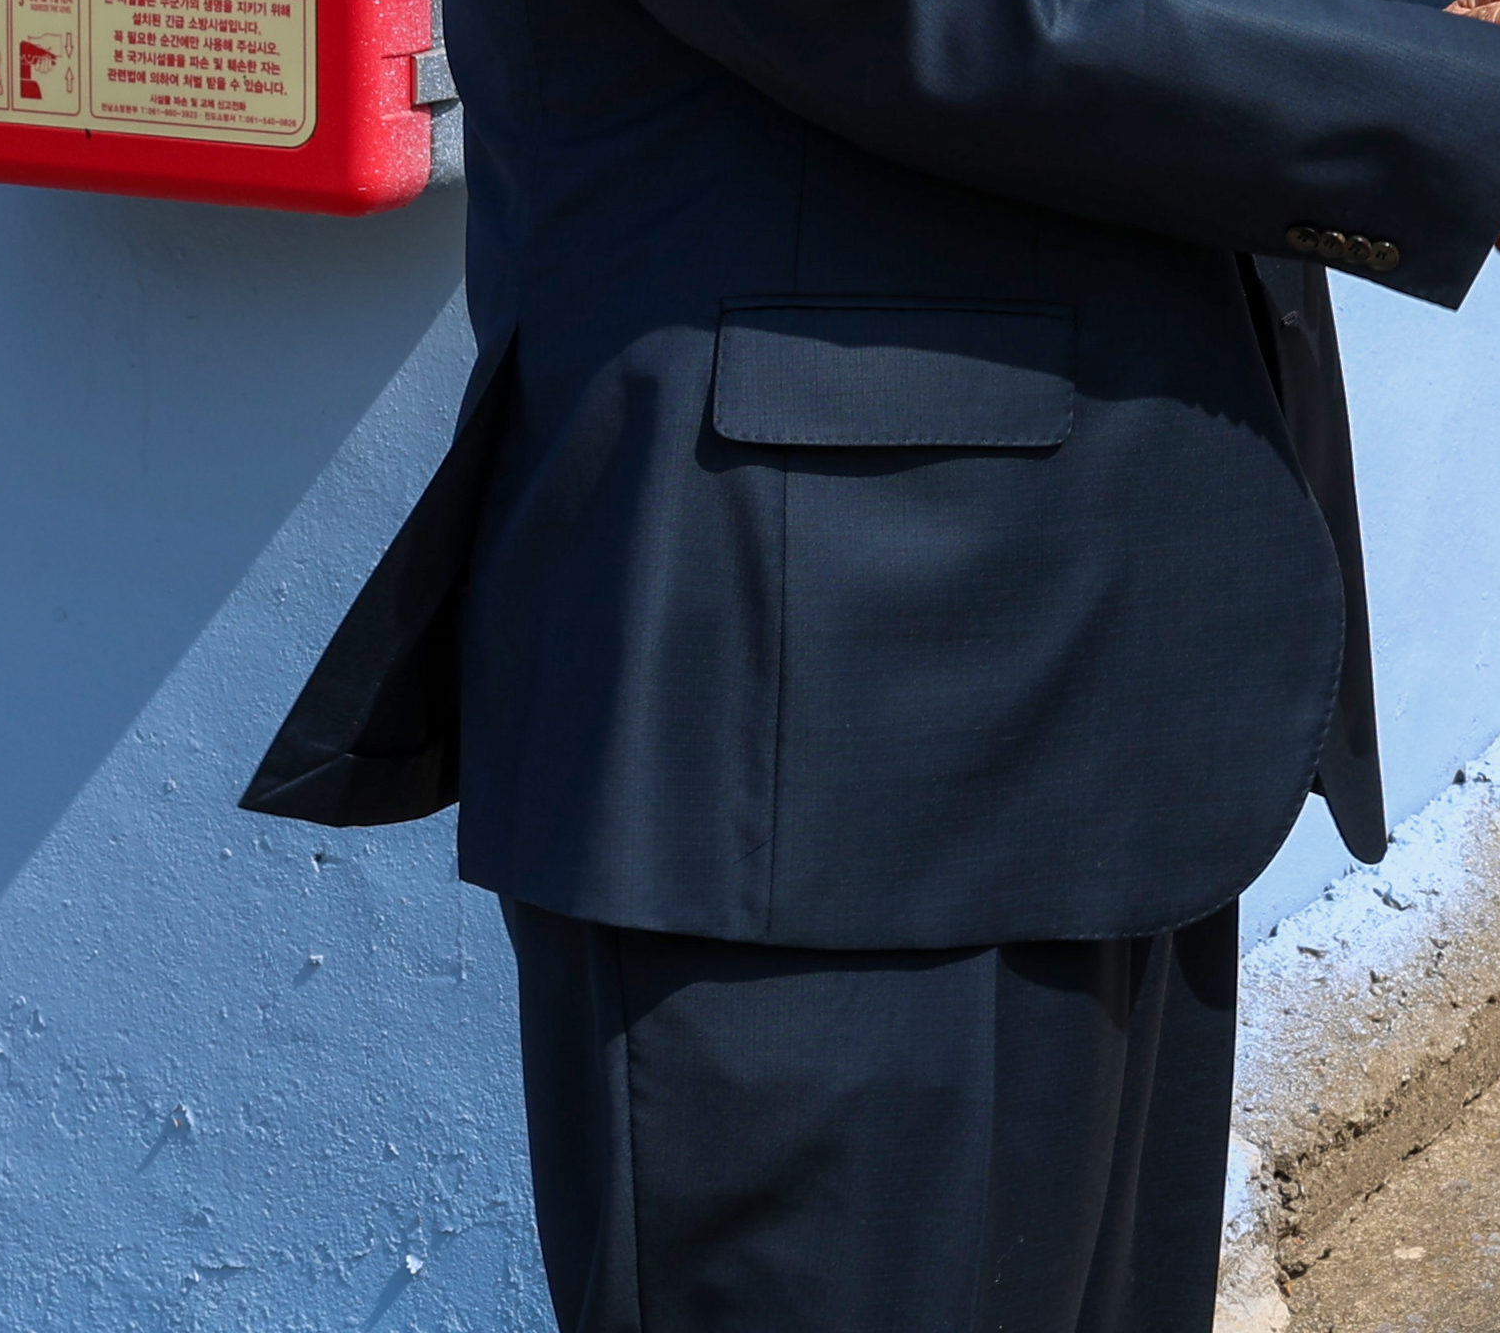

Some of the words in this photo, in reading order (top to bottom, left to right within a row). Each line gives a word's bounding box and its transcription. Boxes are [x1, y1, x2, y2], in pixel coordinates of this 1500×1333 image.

[237, 0, 267, 16] 지키기
[270, 2, 291, 18] 위해
[132, 12, 161, 27] 설치된
[165, 14, 185, 29] 긴급
[188, 16, 261, 35] 소방시설입니다.
[127, 31, 157, 46] 필요한
[160, 34, 200, 49] 순간에만
[203, 37, 233, 52] 사용해
[114, 49, 124, 63] 본
[127, 50, 186, 68] 국가시설물을
[189, 55, 210, 70] 파손
[213, 57, 223, 71] 및
[261, 61, 281, 76] 자는
[107, 68, 146, 84] 관련법에
[150, 72, 179, 87] 의하여
[183, 74, 203, 89] 처벌
[206, 76, 226, 91] 받을
[230, 78, 240, 92] 수
[244, 79, 287, 96] 있습니다.
